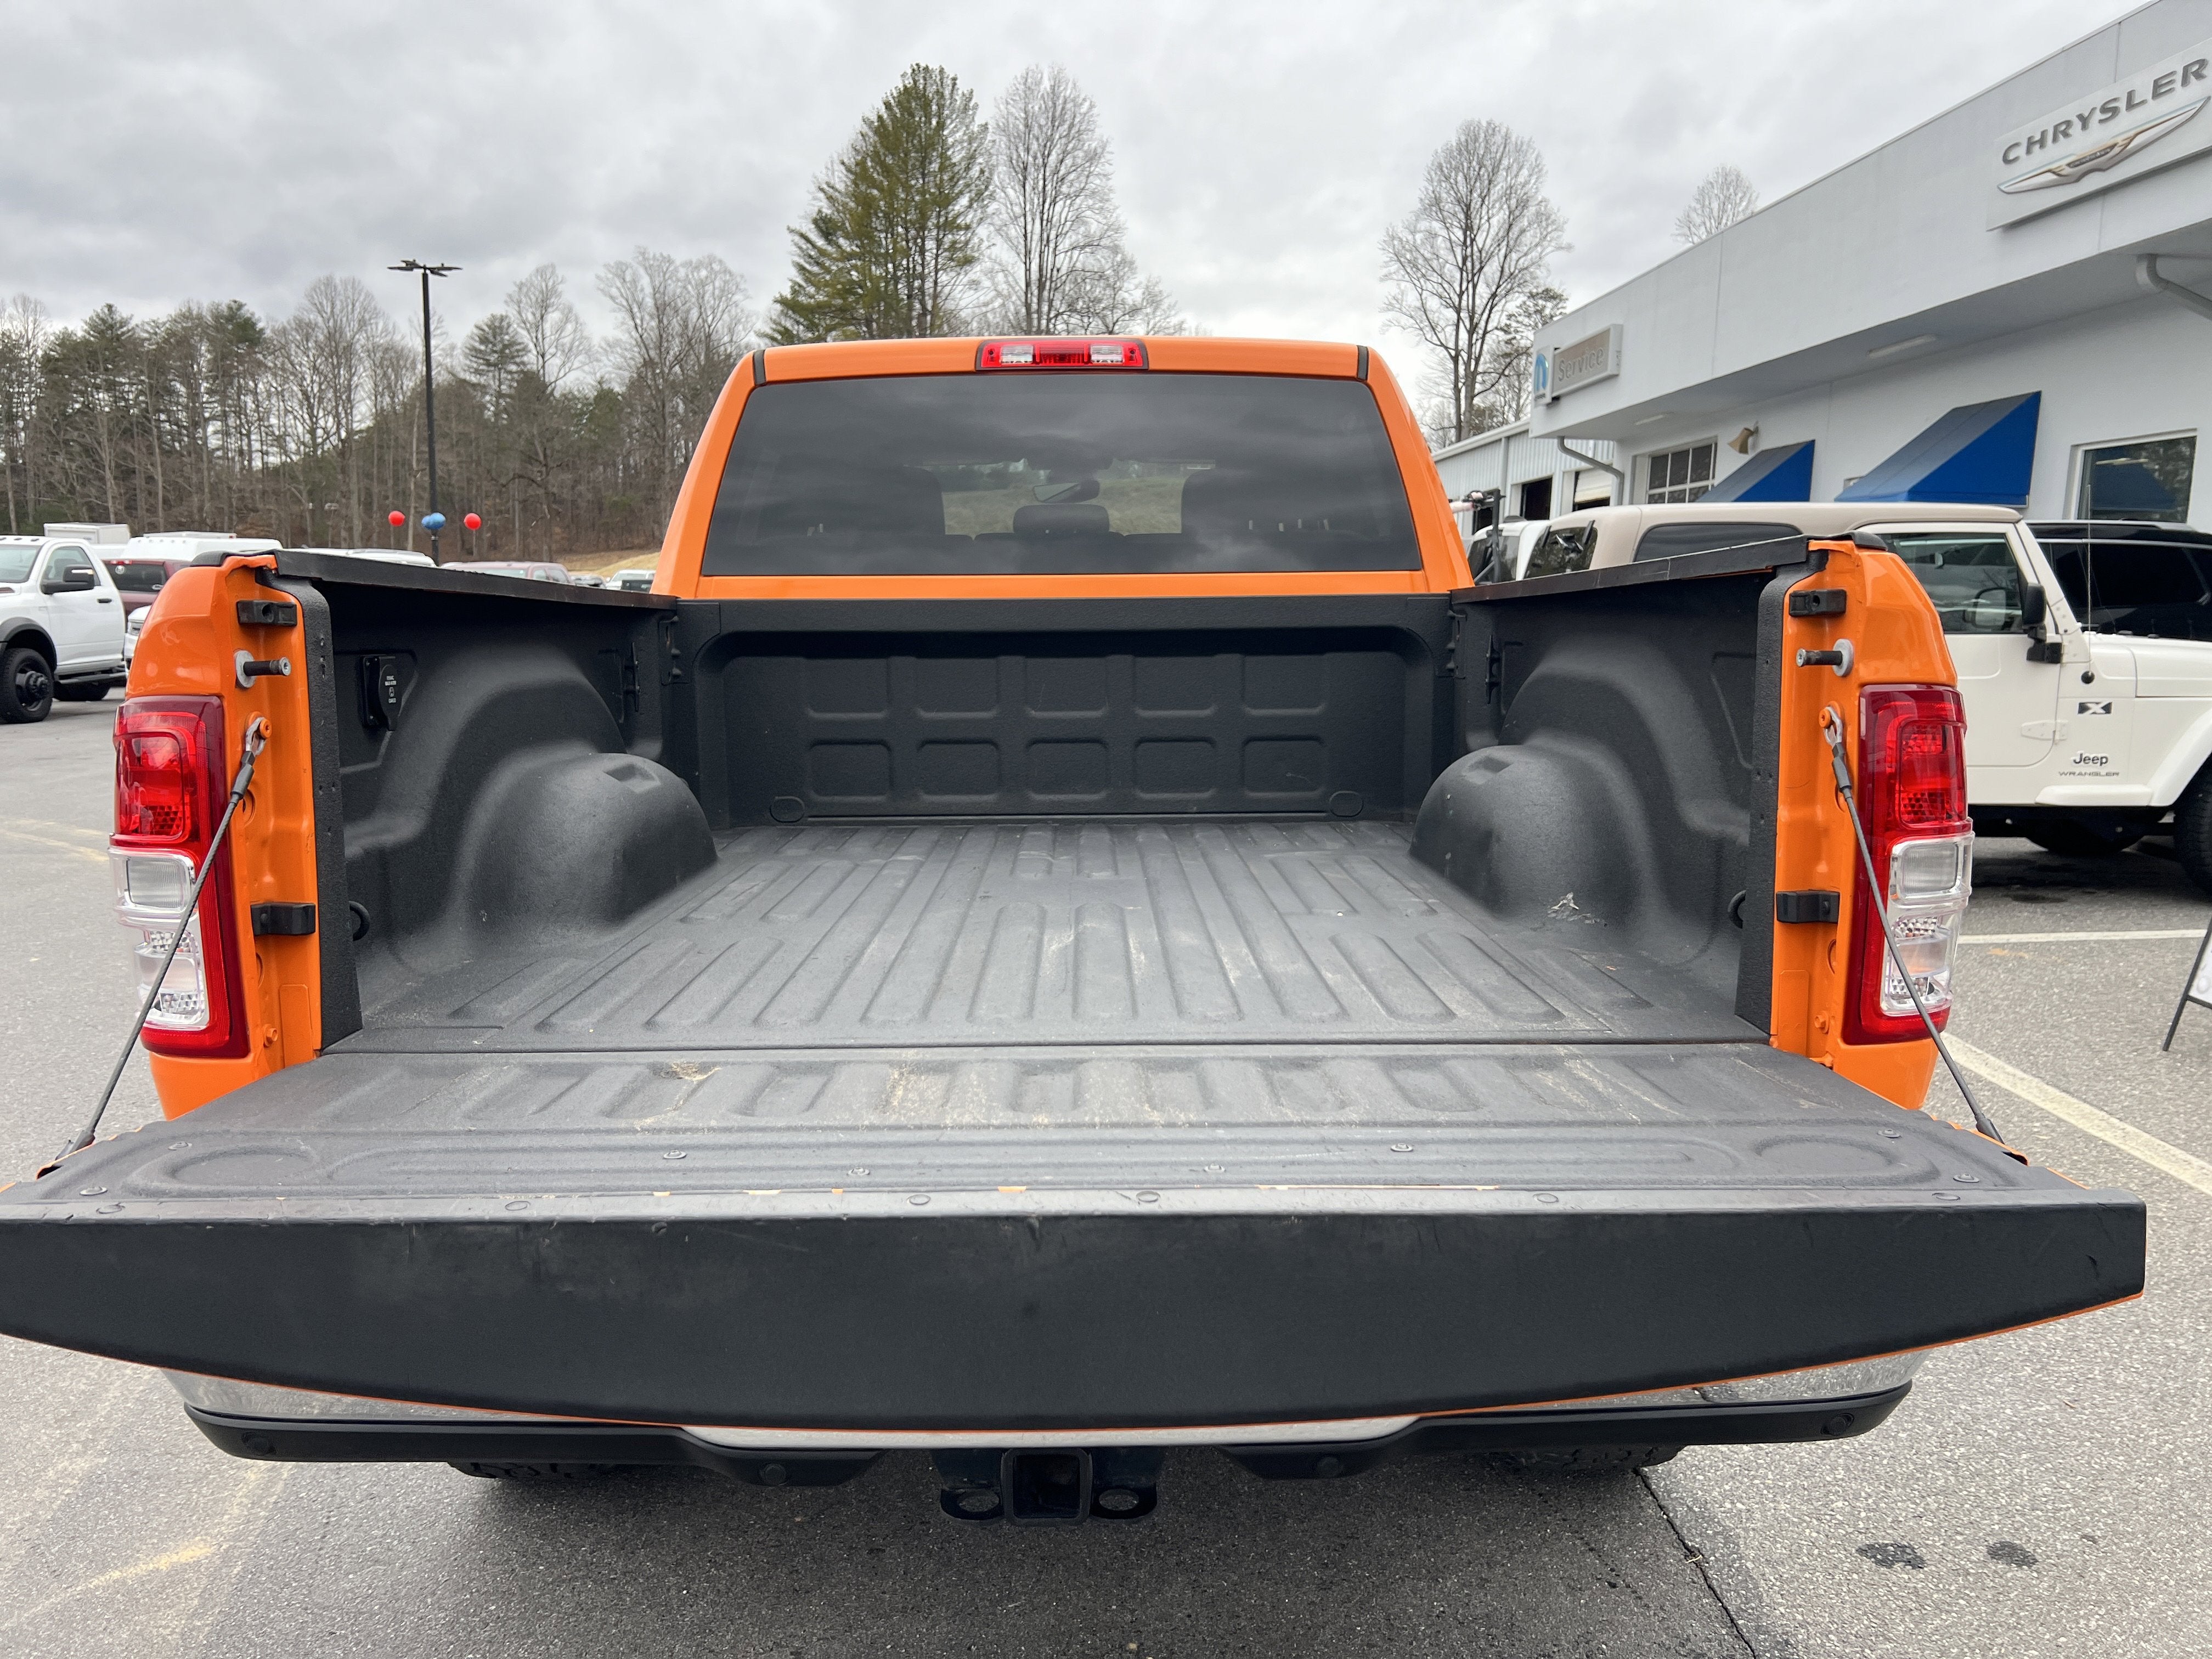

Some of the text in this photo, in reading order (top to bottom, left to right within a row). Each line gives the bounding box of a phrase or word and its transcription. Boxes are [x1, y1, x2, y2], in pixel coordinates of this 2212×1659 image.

[2001, 58, 2209, 165] CHRYSLER
[1558, 347, 1603, 382] Service
[2073, 752, 2109, 766] Jeep
